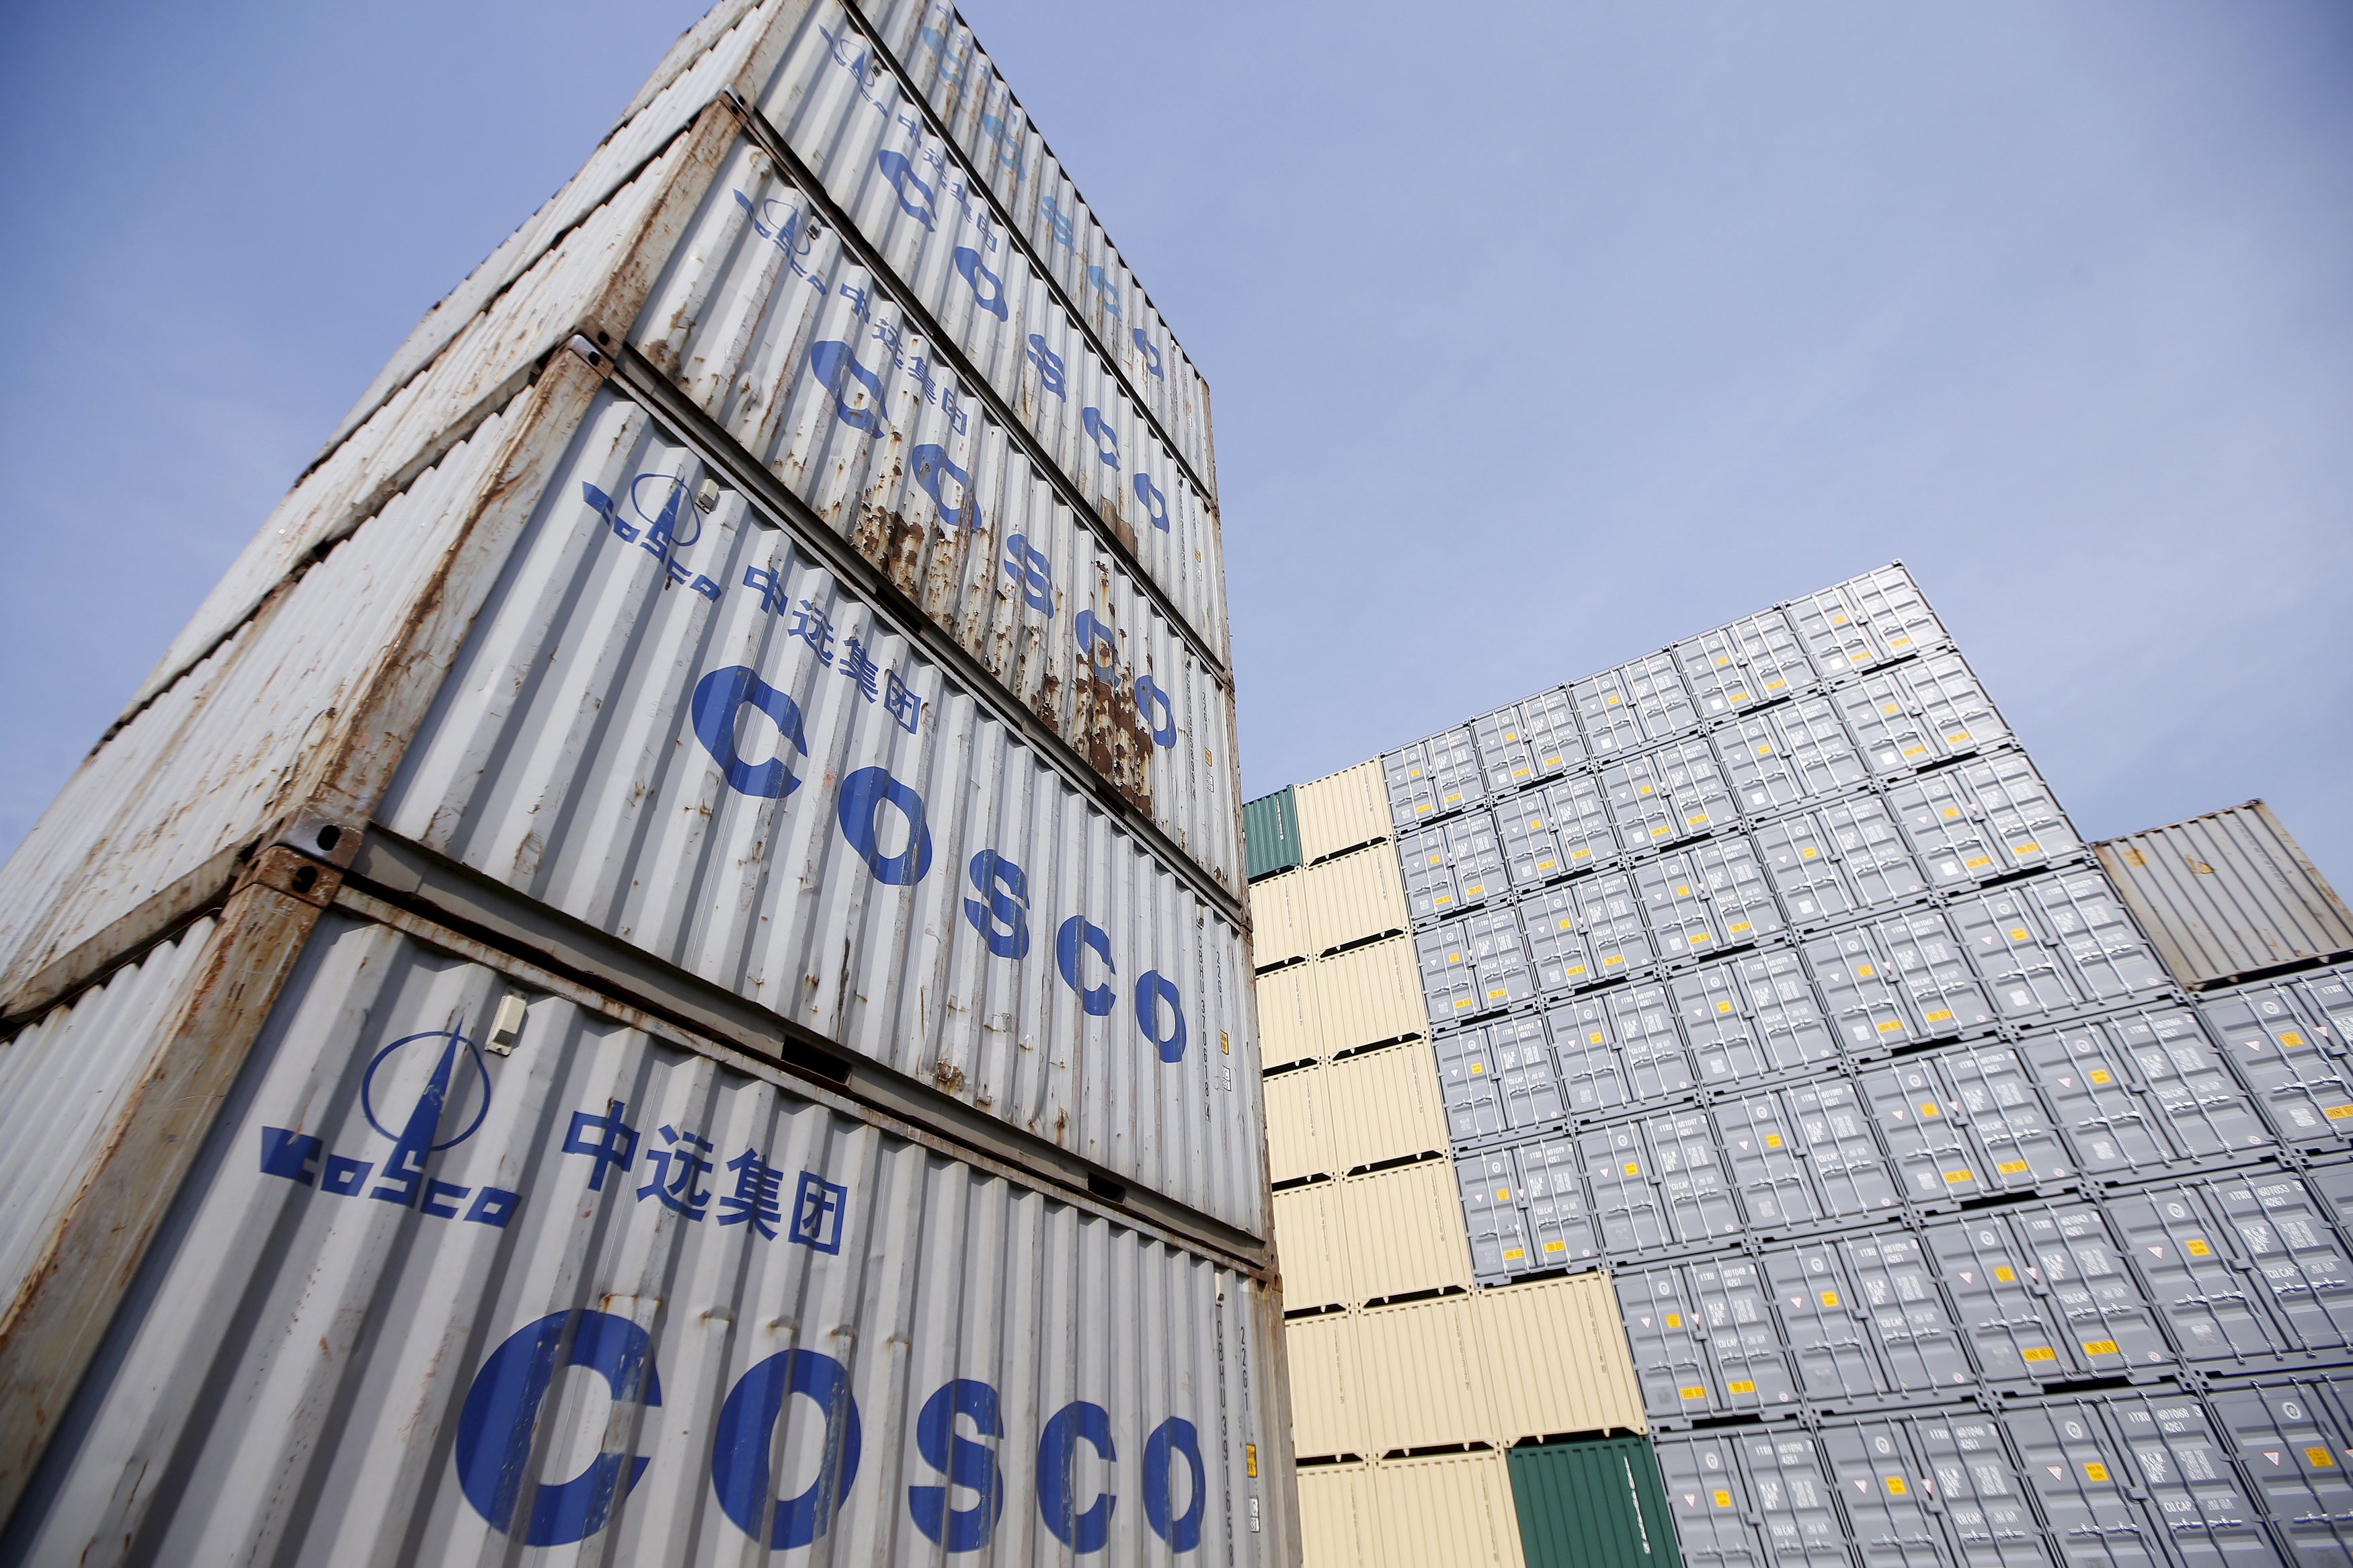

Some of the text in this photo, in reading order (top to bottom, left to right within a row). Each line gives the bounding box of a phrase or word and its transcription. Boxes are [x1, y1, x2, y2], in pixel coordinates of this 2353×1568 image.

[898, 114, 997, 251] 中远集团
[840, 282, 966, 436] 中远集团
[878, 149, 1170, 533] COSCO
[810, 340, 1176, 750] COSCO
[743, 563, 922, 735] 中远集团
[692, 665, 1187, 1065] COSCO
[260, 1126, 522, 1229] COSCO
[562, 1100, 847, 1255] 中远集团
[1547, 1147, 1564, 1156] 601079
[1678, 1118, 1698, 1128] 601047
[455, 1309, 1205, 1555] COSCO
[1217, 1320, 1234, 1567] CBHU 391658
[1240, 1327, 1248, 1411] 22G1
